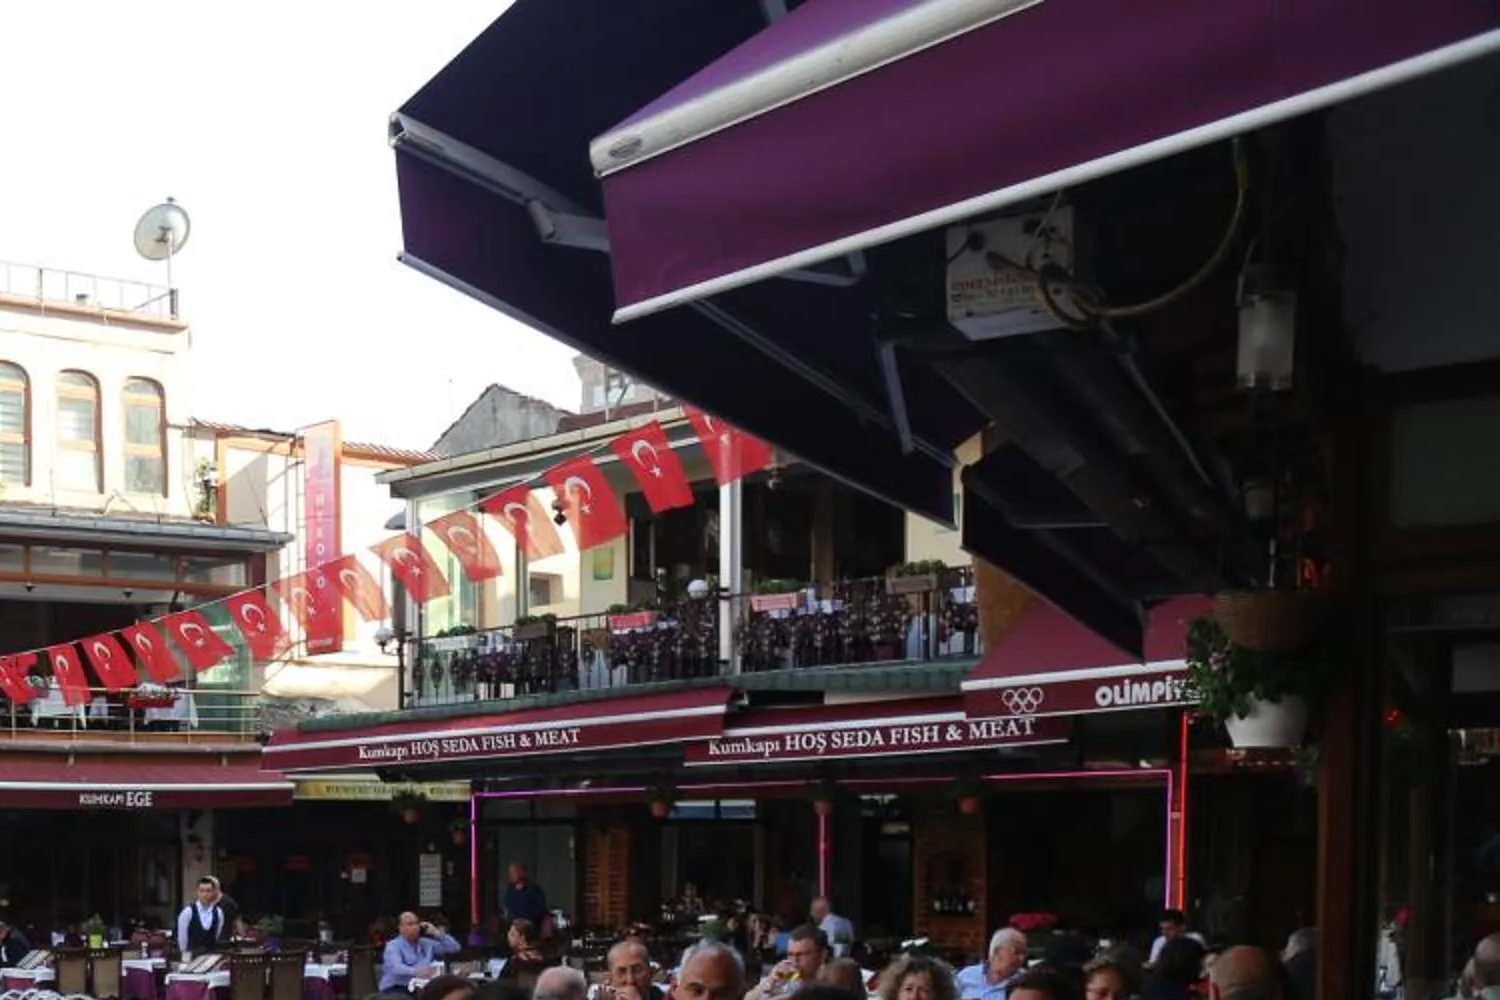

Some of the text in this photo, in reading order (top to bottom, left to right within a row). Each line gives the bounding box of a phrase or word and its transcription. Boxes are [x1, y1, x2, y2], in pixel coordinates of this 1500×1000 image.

[1095, 675, 1196, 706] OLİMPİY
[411, 740, 440, 759] HOŞ
[442, 737, 480, 754] SEDA
[481, 733, 516, 751] FISH
[519, 733, 532, 748] &
[534, 728, 581, 746] MEAT
[708, 718, 1036, 757] Kumkapı HOŞ SEDA FISH & MEAT
[125, 791, 154, 807] EGE
